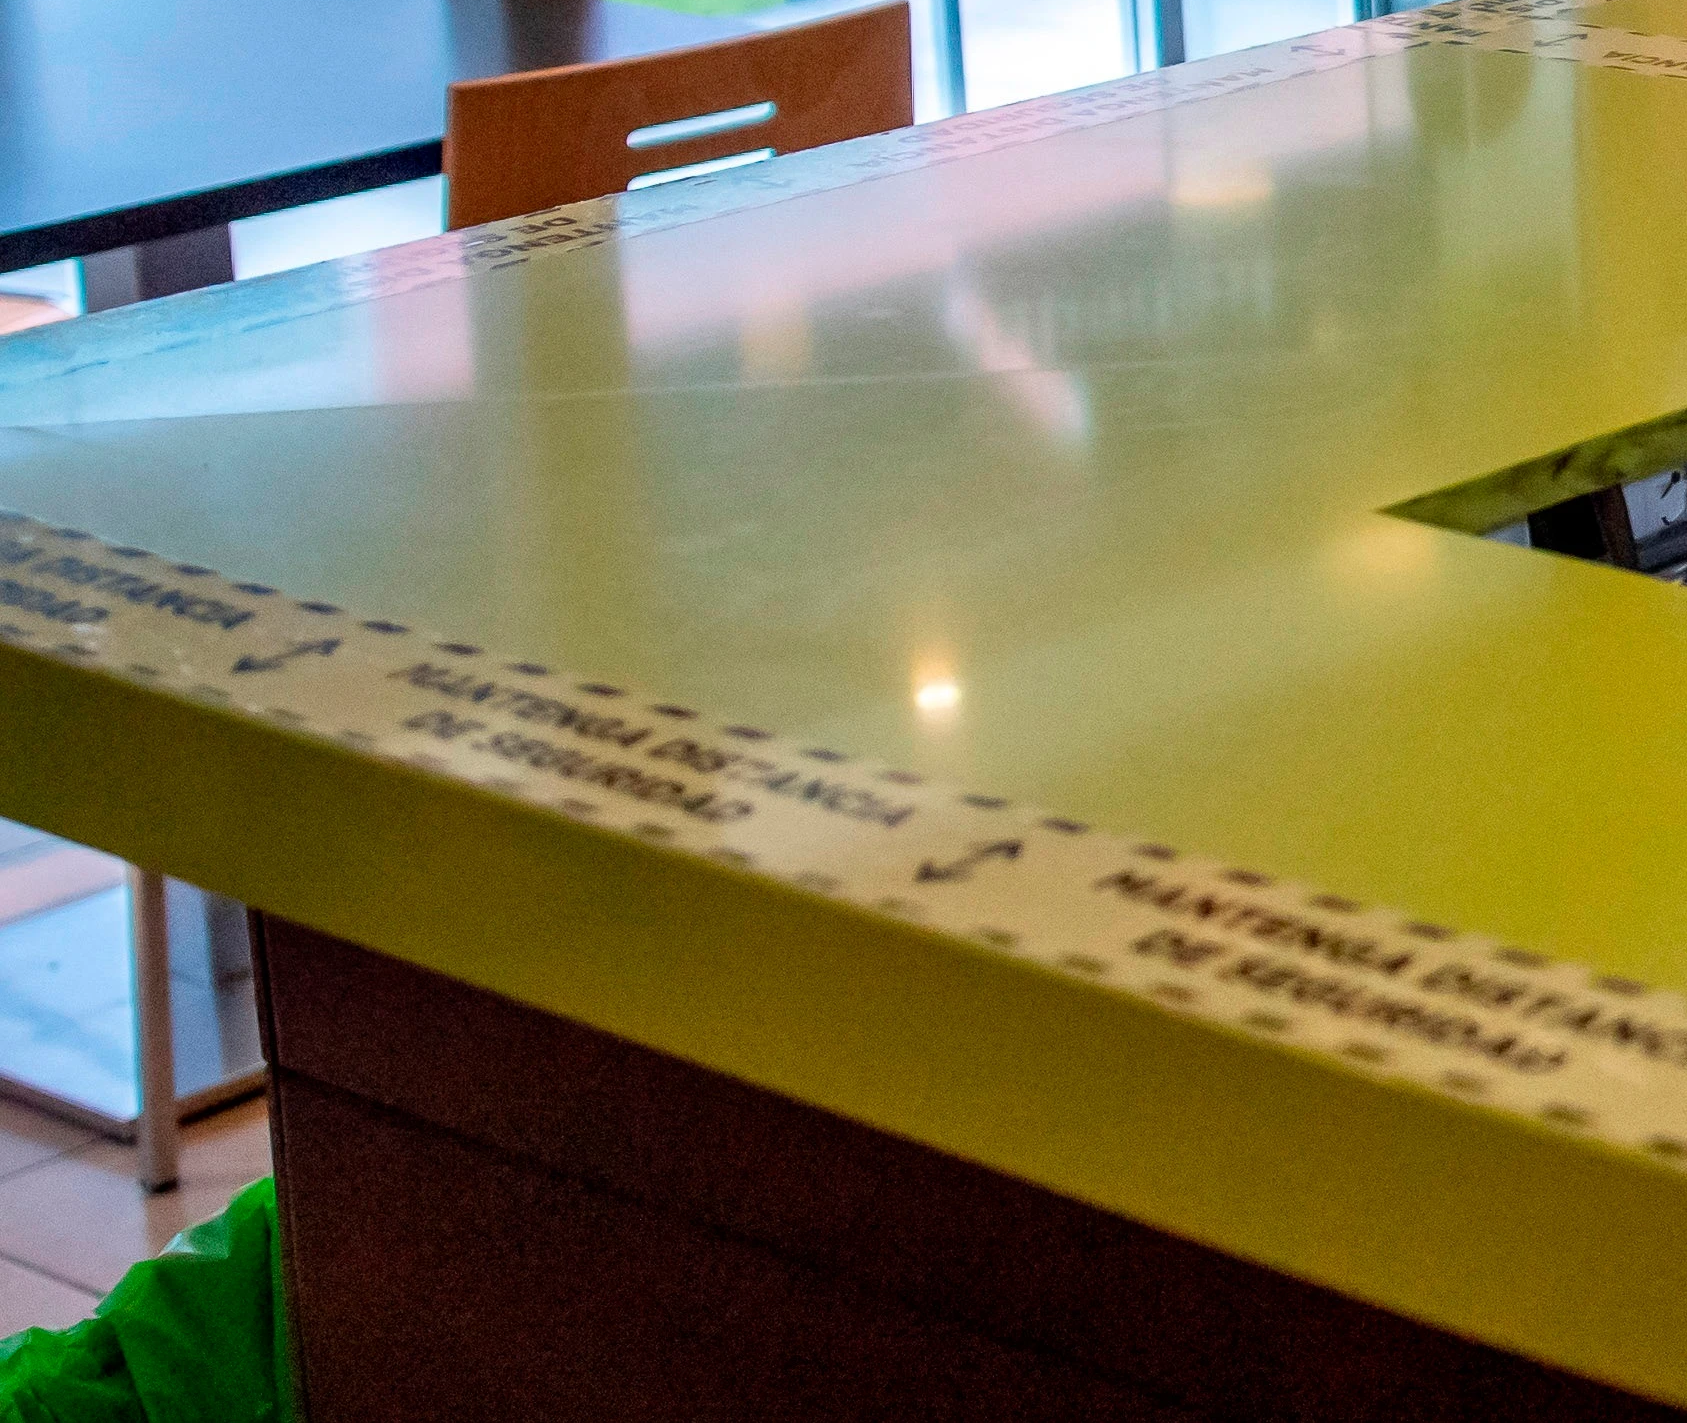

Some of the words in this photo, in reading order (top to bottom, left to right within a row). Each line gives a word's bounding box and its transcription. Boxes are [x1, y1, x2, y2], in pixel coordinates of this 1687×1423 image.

[393, 660, 654, 748] MANTENGA
[648, 737, 916, 828] DISTANCIA
[403, 709, 489, 741] DE
[471, 729, 755, 824] SEGURIDAD
[1097, 869, 1414, 977] MANTENGA
[1130, 928, 1226, 968] DE
[1218, 954, 1570, 1076] SEGURIDAD
